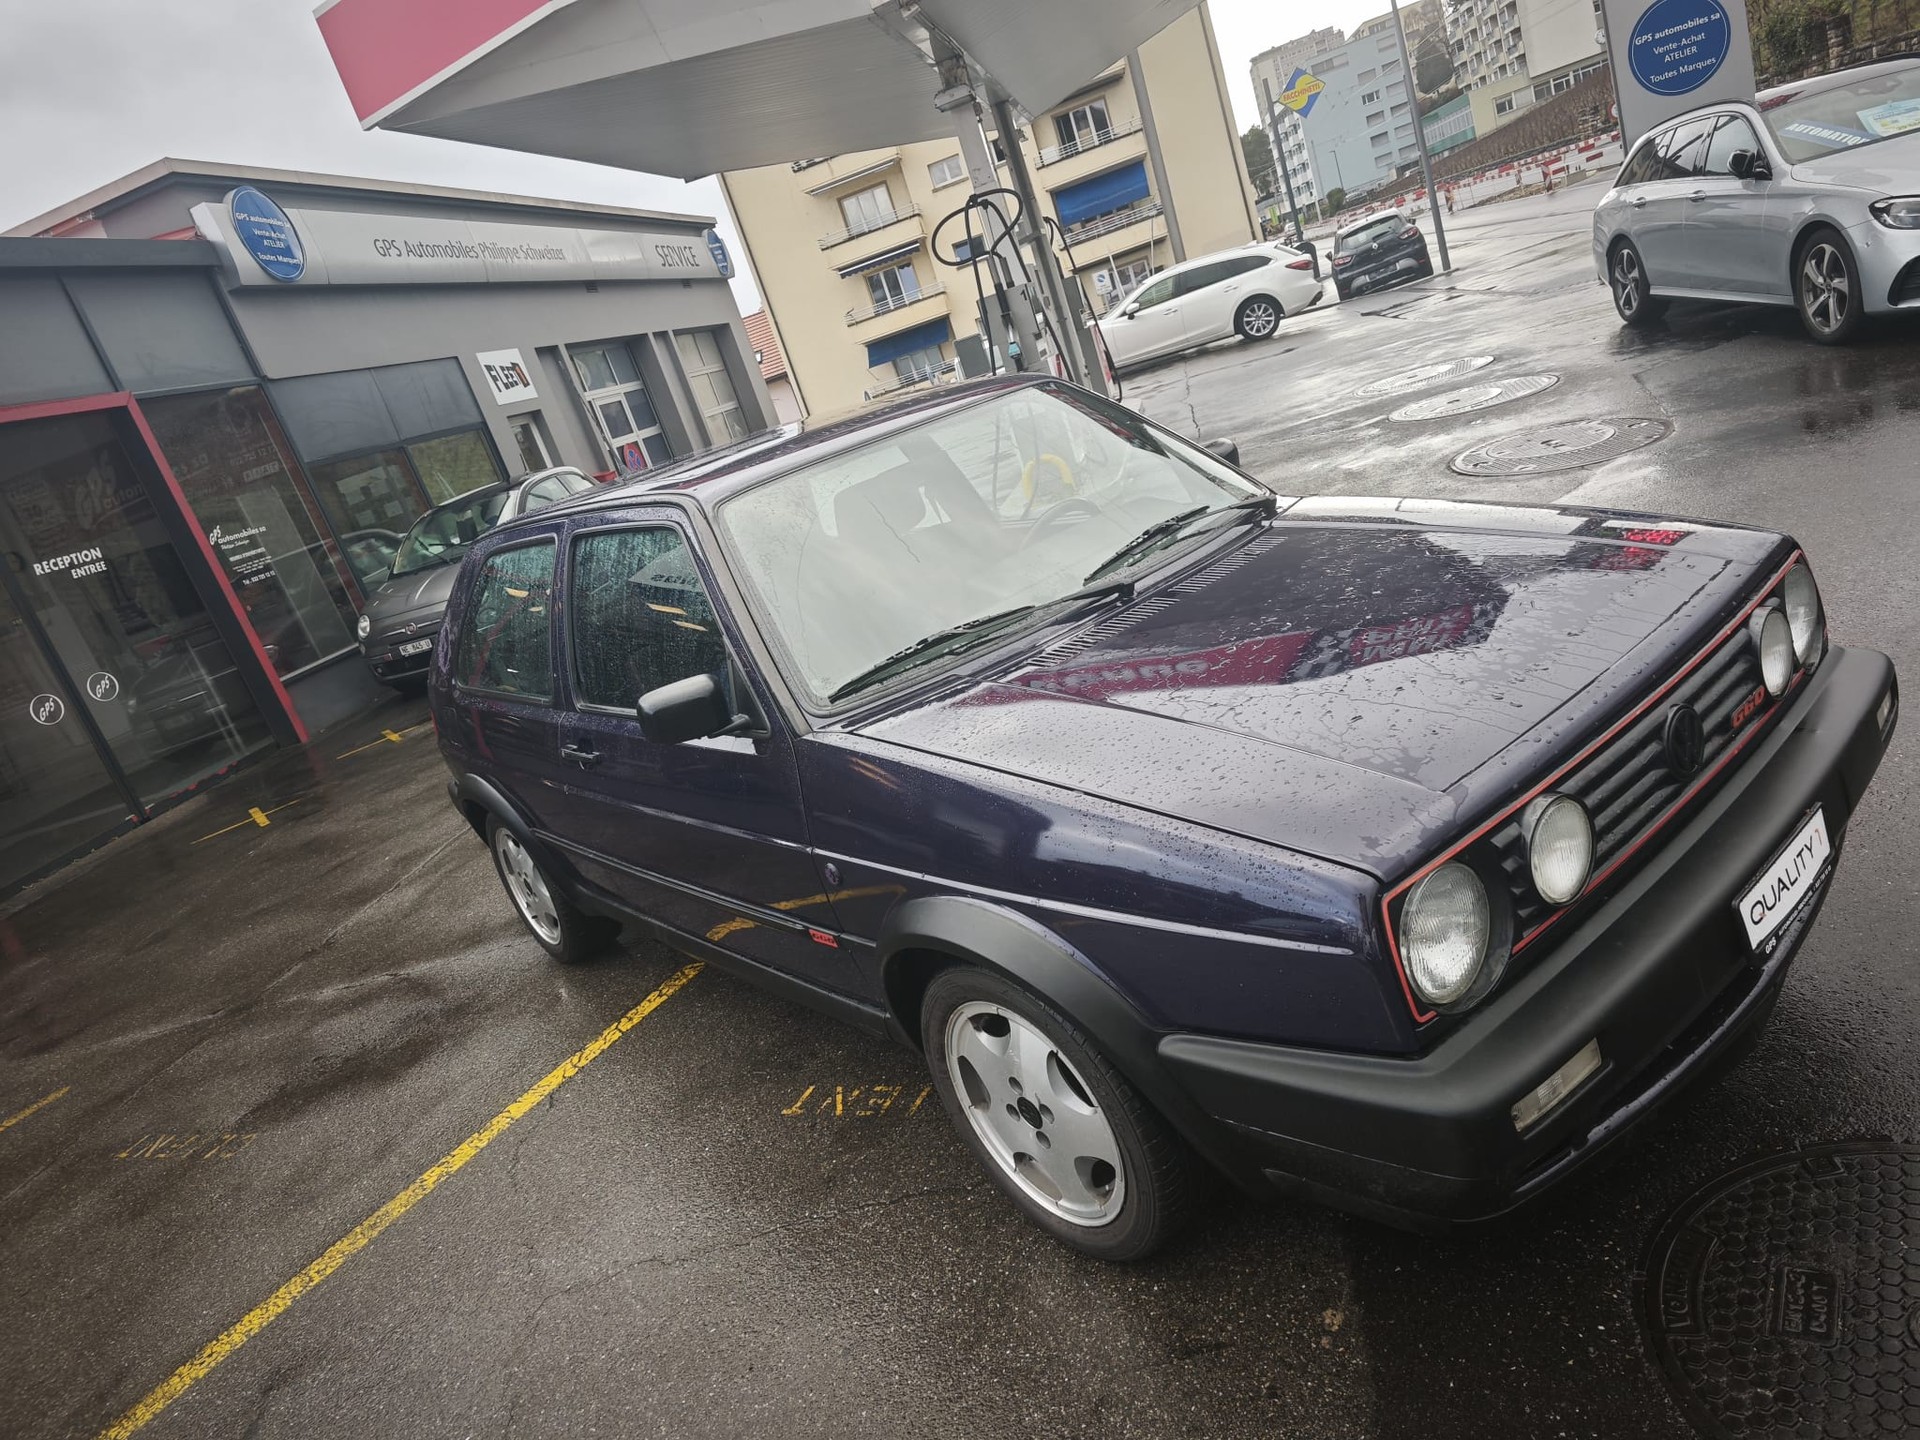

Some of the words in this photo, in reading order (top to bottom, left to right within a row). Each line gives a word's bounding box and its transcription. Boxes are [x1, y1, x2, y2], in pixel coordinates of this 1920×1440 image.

[1634, 33, 1653, 45] GPS
[1654, 17, 1709, 40] automobiles
[1710, 12, 1720, 21] sa
[1653, 32, 1706, 55] Vente-Achat
[1664, 46, 1698, 63] ATELIER
[1649, 69, 1678, 84] Toutes
[1679, 57, 1717, 74] Marques
[1283, 82, 1321, 101] FACCHINETTI
[373, 238, 402, 258] GPS
[403, 239, 479, 259] Automobiles
[477, 241, 519, 263] Philippe
[519, 244, 567, 261] Schweizer
[654, 245, 701, 267] SERVICE
[217, 527, 259, 544] automobiles
[33, 547, 103, 575] RECEPTION
[70, 561, 108, 579] ENTREE
[95, 675, 110, 698] GPS
[39, 697, 55, 722] GPS
[1731, 685, 1766, 729] G60
[1750, 835, 1814, 926] QUALITY
[1765, 936, 1777, 954] GPS
